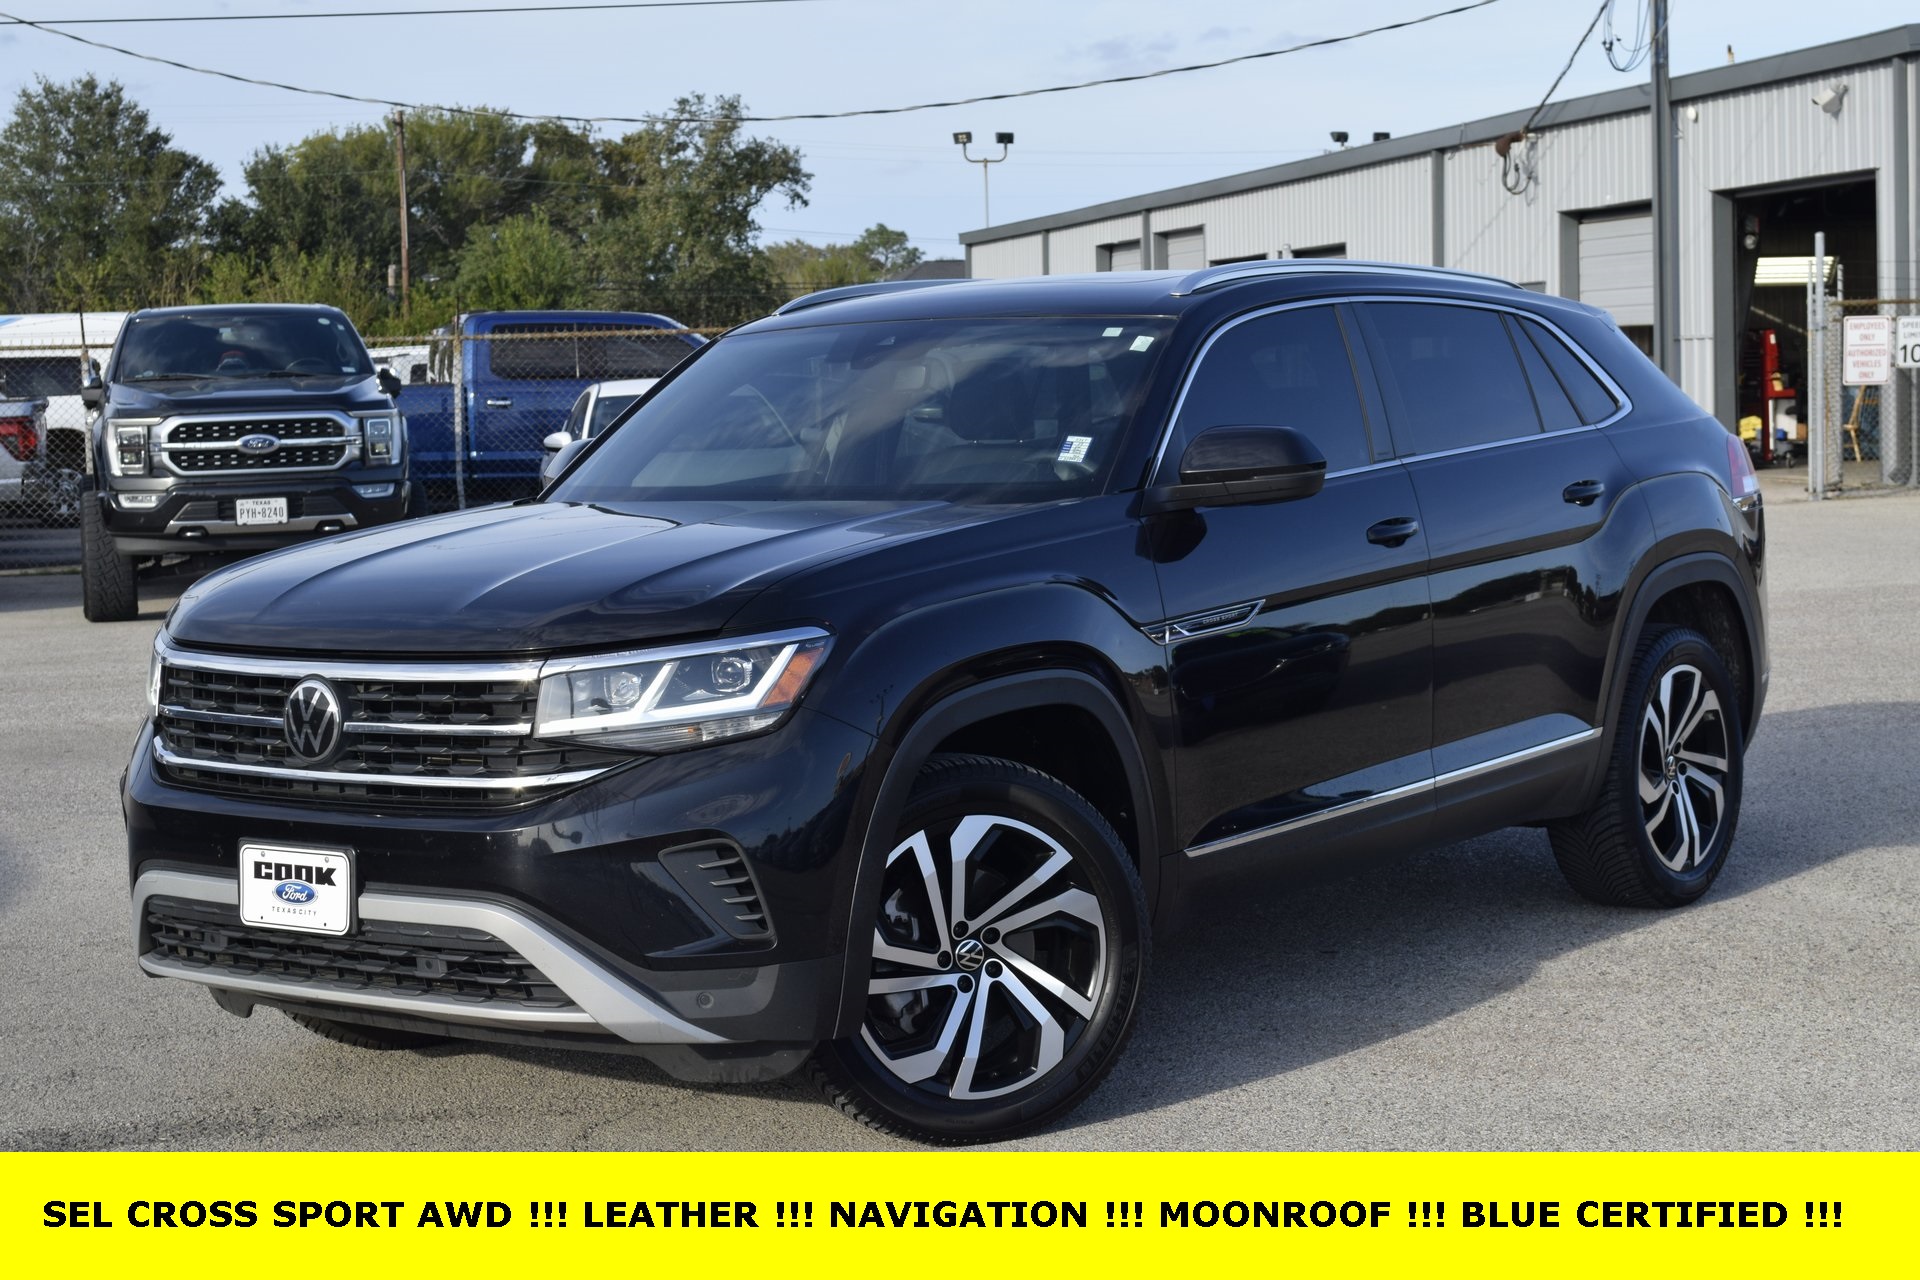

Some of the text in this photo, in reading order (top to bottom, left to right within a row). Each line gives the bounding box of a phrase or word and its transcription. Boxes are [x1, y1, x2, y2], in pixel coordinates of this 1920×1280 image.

[1849, 322, 1886, 330] EMPLOYEES
[1859, 333, 1875, 341] ONLY
[1848, 349, 1887, 357] AUTHORIZED
[1900, 344, 1920, 363] 10
[1852, 360, 1882, 368] VEHICLES
[1858, 371, 1874, 379] ONLY
[254, 861, 336, 887] COOK
[281, 884, 308, 902] Ford
